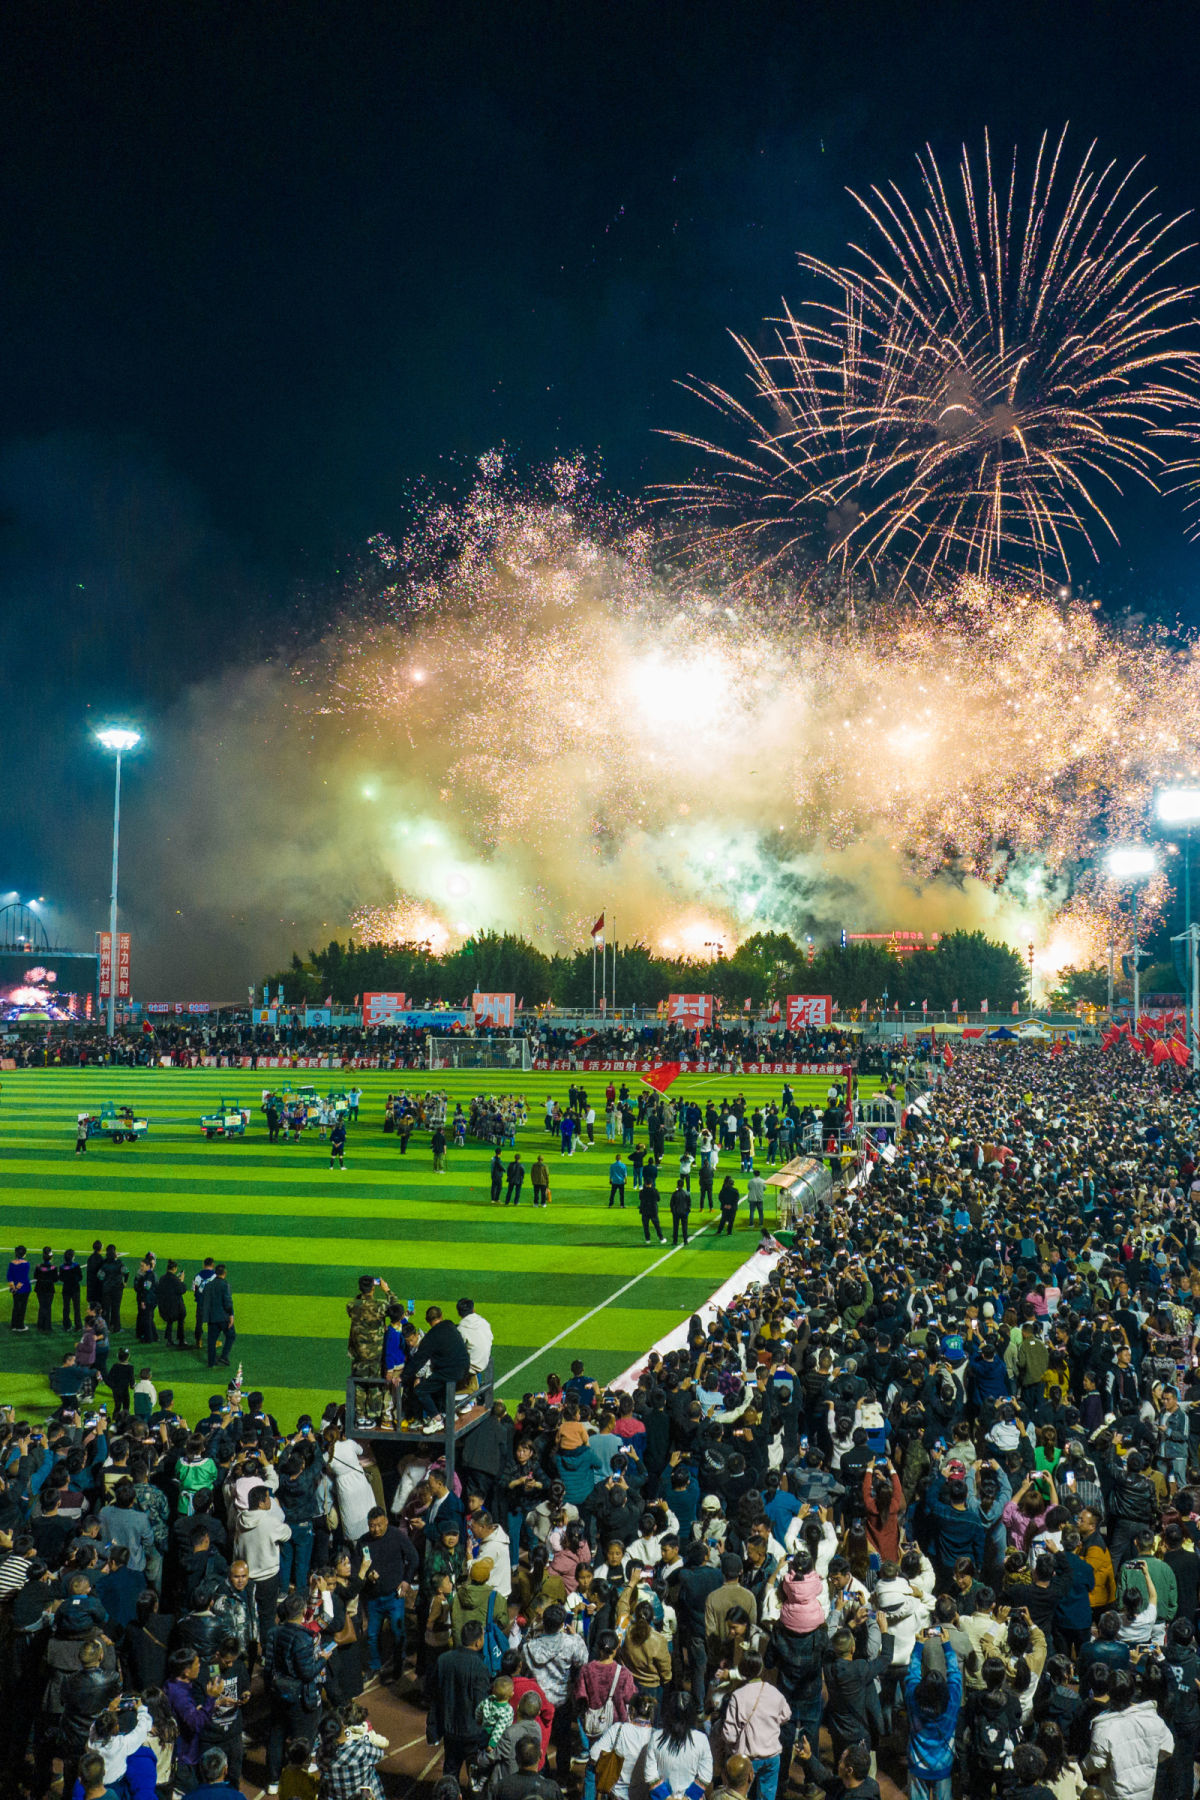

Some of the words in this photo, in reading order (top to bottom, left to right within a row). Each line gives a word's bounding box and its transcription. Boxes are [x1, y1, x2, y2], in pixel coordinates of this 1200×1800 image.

[101, 936, 111, 994] 贵州村超
[120, 936, 129, 994] 活力四射
[175, 1003, 182, 1013] 5
[366, 994, 402, 1025] 贵
[476, 996, 511, 1025] 州
[671, 996, 709, 1028] 村
[790, 997, 826, 1028] 超
[589, 1061, 637, 1071] 活力四射
[642, 1062, 688, 1073] 全民身
[749, 1064, 797, 1074] 全民足球
